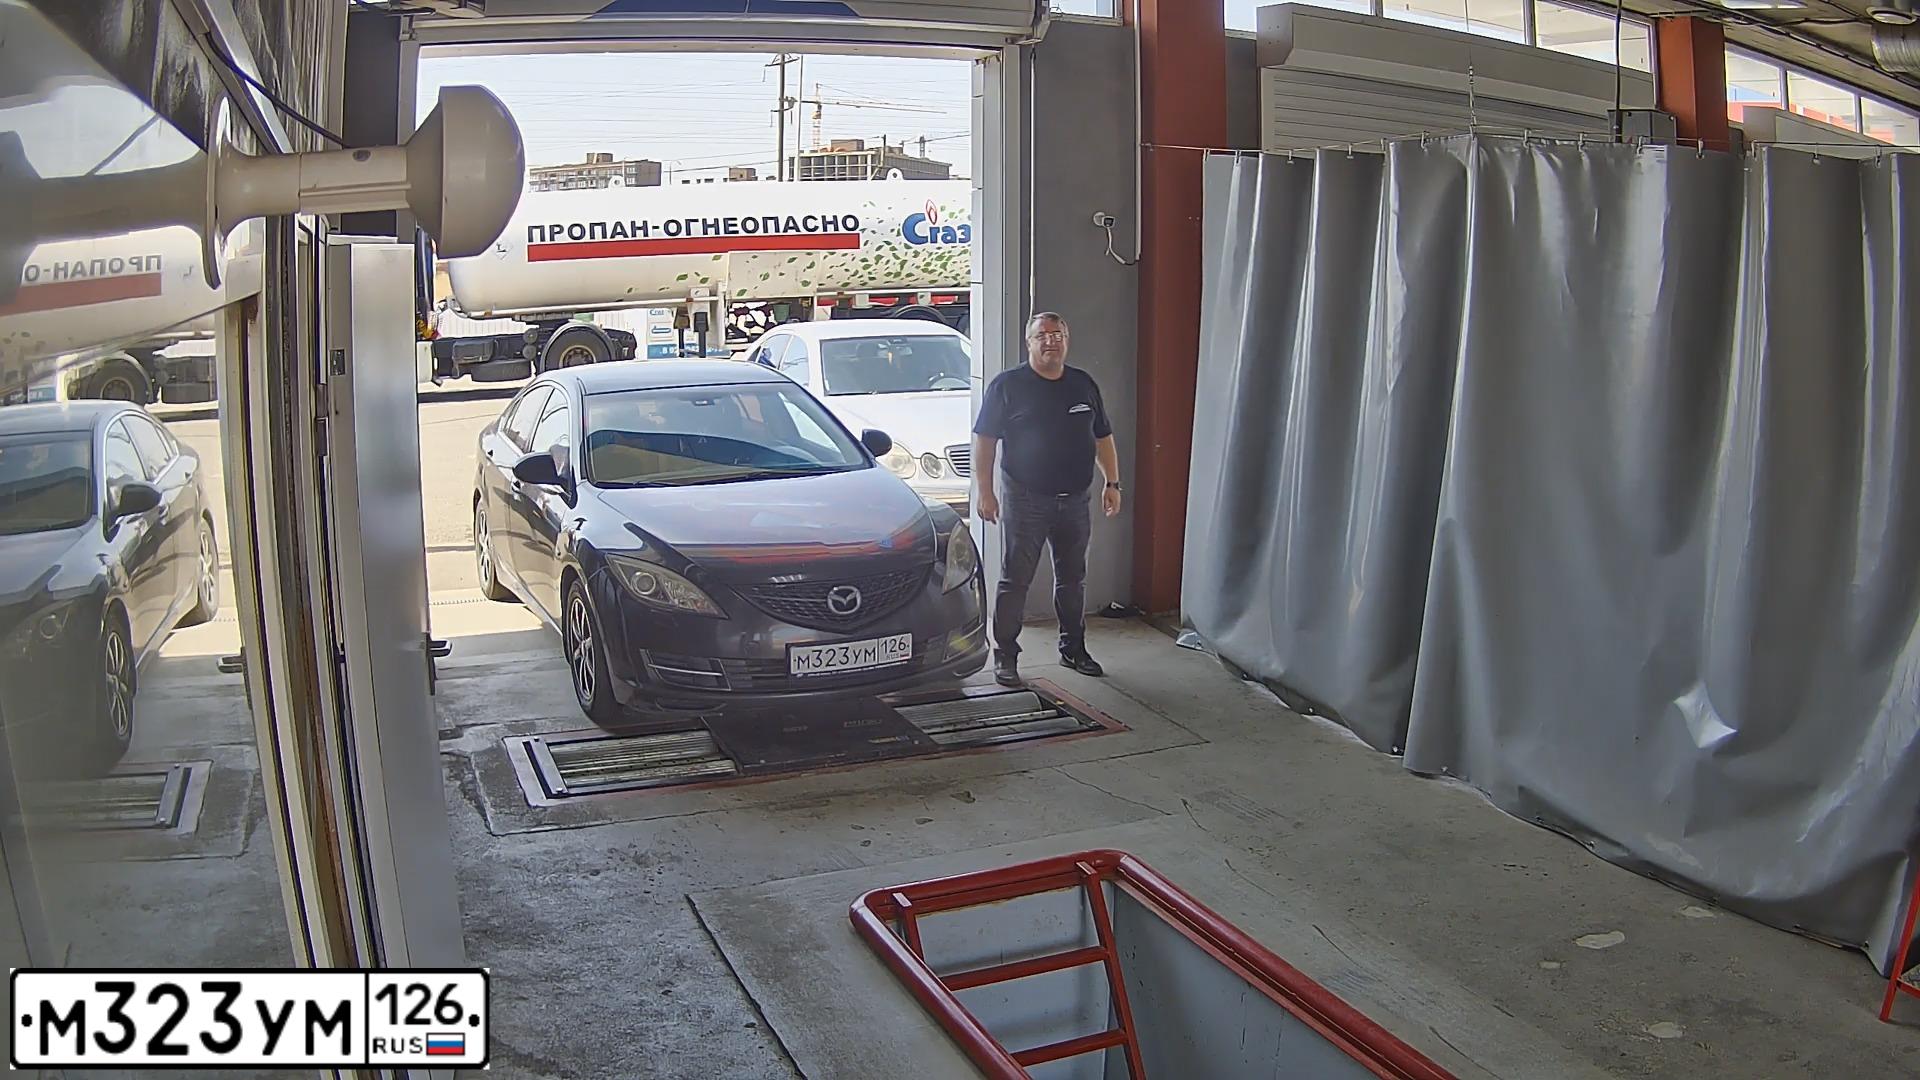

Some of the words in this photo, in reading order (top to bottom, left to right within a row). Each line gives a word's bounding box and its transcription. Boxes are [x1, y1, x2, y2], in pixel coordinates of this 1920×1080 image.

[527, 213, 860, 244] ПРОПАН-ОГНЕОПАСНО
[797, 646, 876, 670] М323УМ
[881, 637, 905, 654] 126
